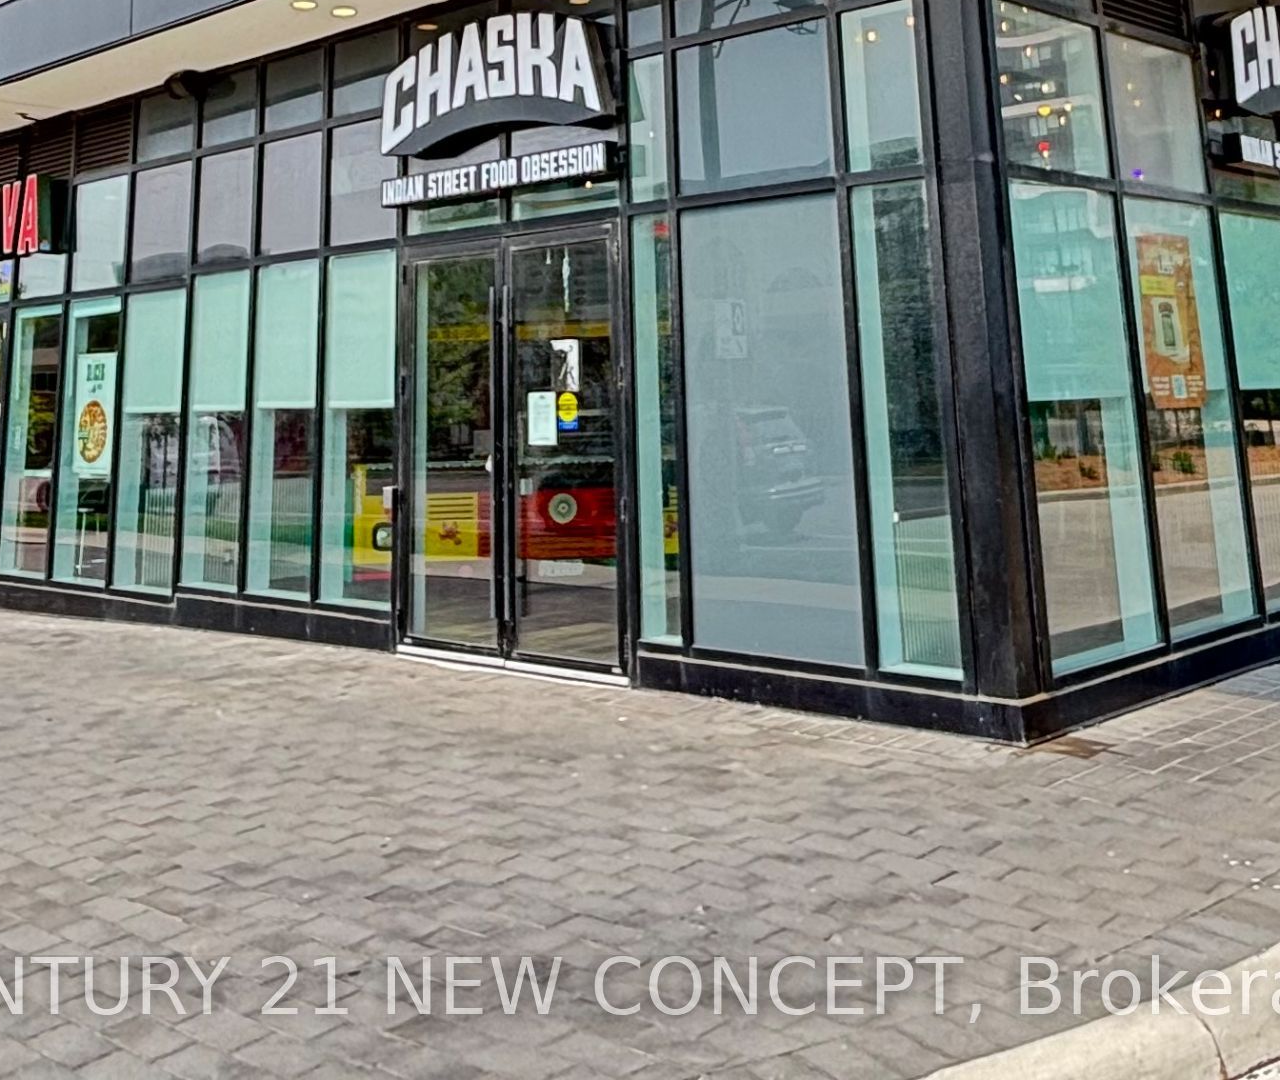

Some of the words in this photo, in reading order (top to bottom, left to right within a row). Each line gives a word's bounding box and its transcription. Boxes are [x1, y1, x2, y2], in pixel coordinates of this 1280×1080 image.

[381, 12, 601, 155] CHASKA
[382, 175, 424, 206] INDIAN
[428, 166, 478, 198] STREET
[481, 158, 518, 190] FOOD
[521, 143, 604, 184] OBSESSION
